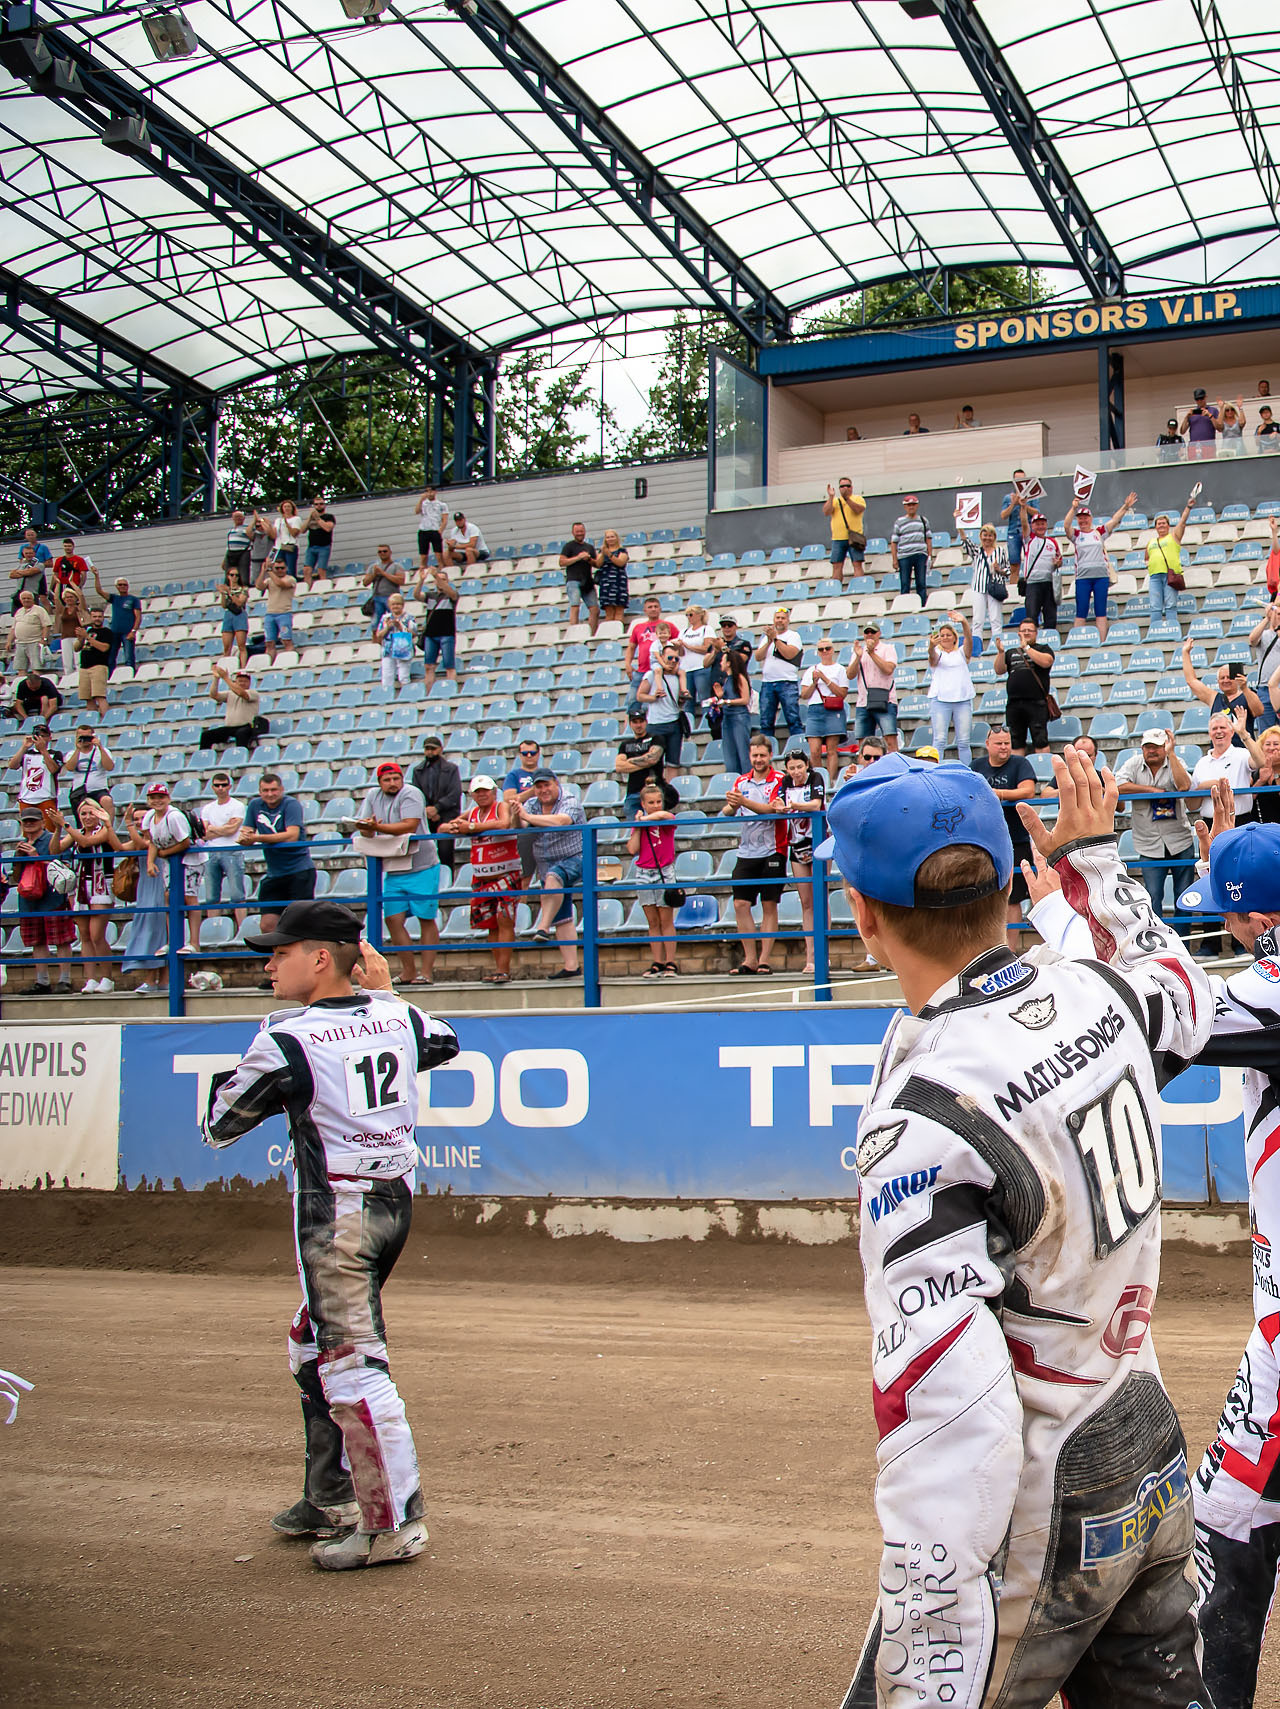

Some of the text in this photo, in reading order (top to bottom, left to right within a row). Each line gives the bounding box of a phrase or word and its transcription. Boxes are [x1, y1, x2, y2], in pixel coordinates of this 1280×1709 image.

[954, 292, 1242, 350] SPONSORS V.I.P.
[635, 478, 648, 499] D
[354, 1051, 400, 1110] 12
[416, 1145, 482, 1169] NLINE
[1077, 1078, 1157, 1243] 10
[909, 1542, 927, 1700] GASTROBARS
[924, 1559, 964, 1674] BEAR
